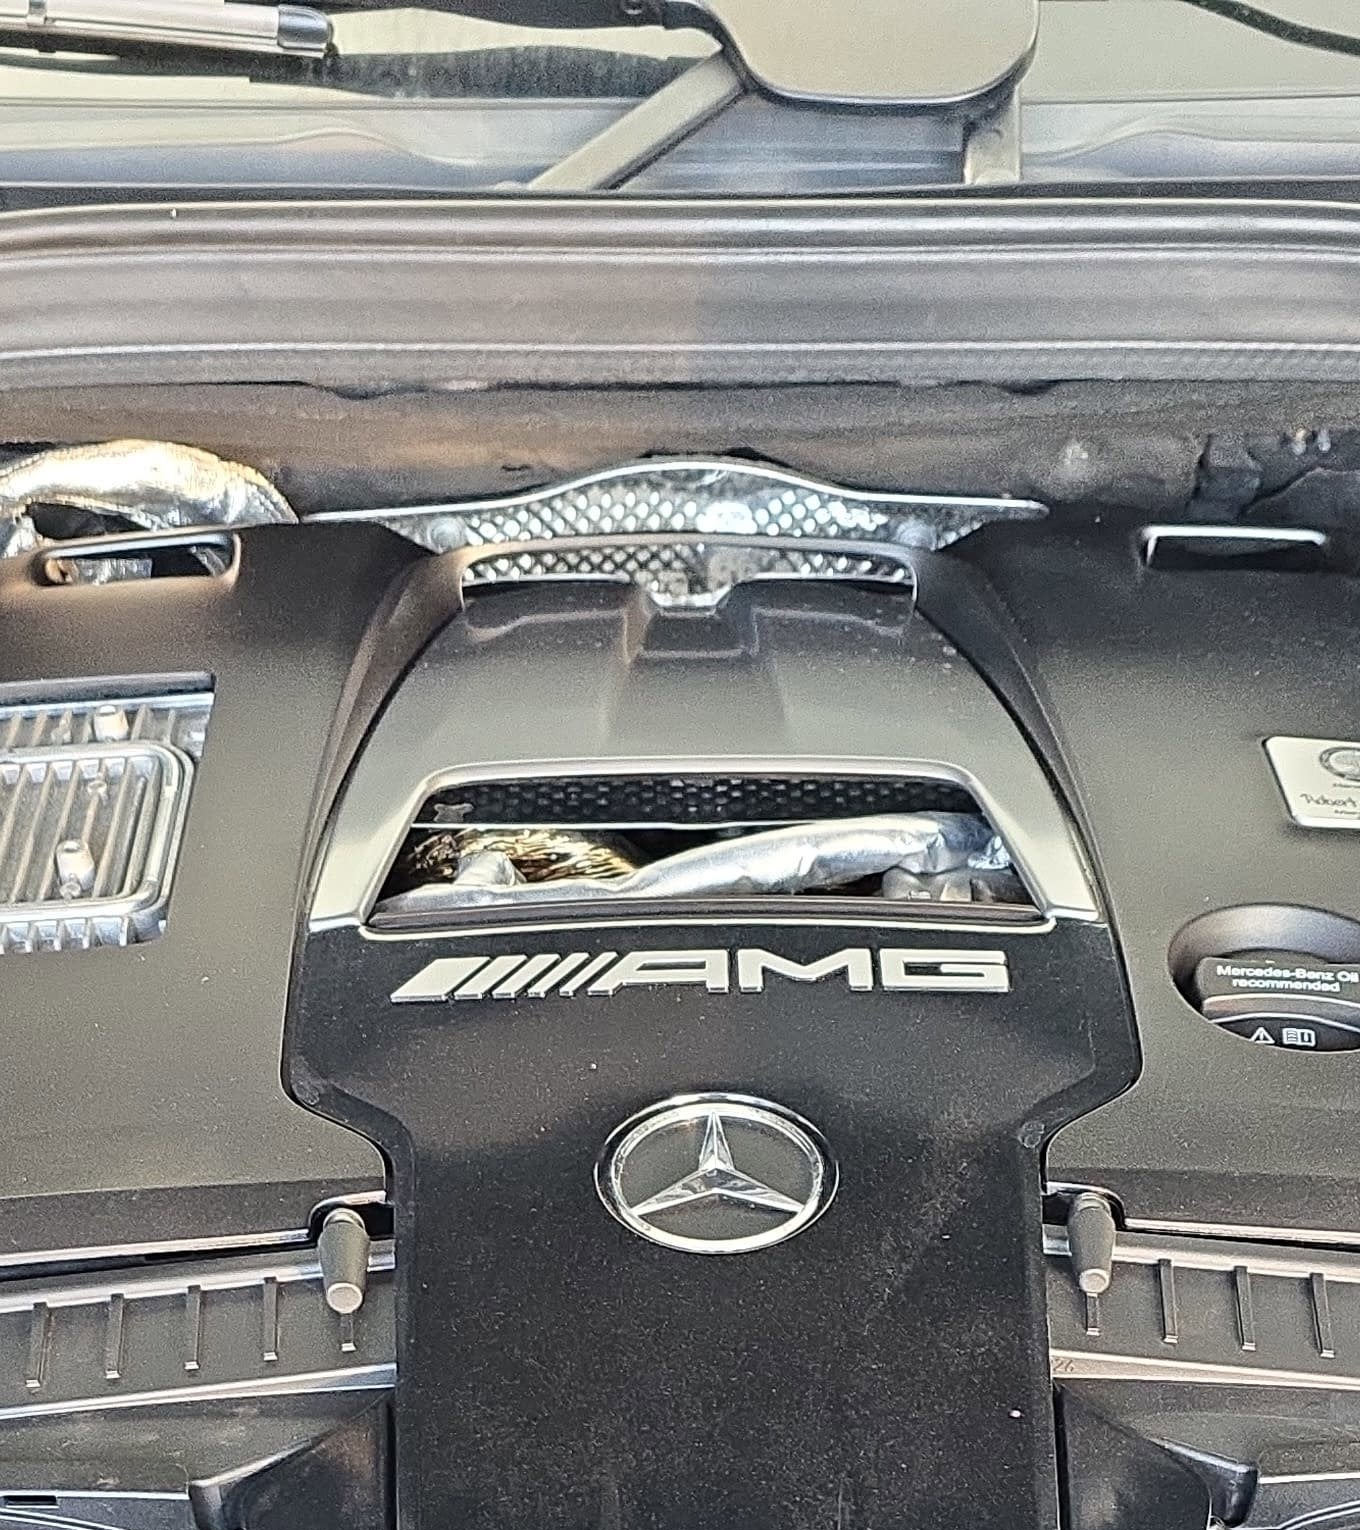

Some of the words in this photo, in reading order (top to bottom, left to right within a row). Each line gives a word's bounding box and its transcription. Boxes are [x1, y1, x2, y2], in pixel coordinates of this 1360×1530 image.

[587, 948, 1008, 995] AMG
[1216, 965, 1335, 981] Mercedes-Benz
[1336, 971, 1360, 983] Oil
[1232, 978, 1340, 992] recommended
